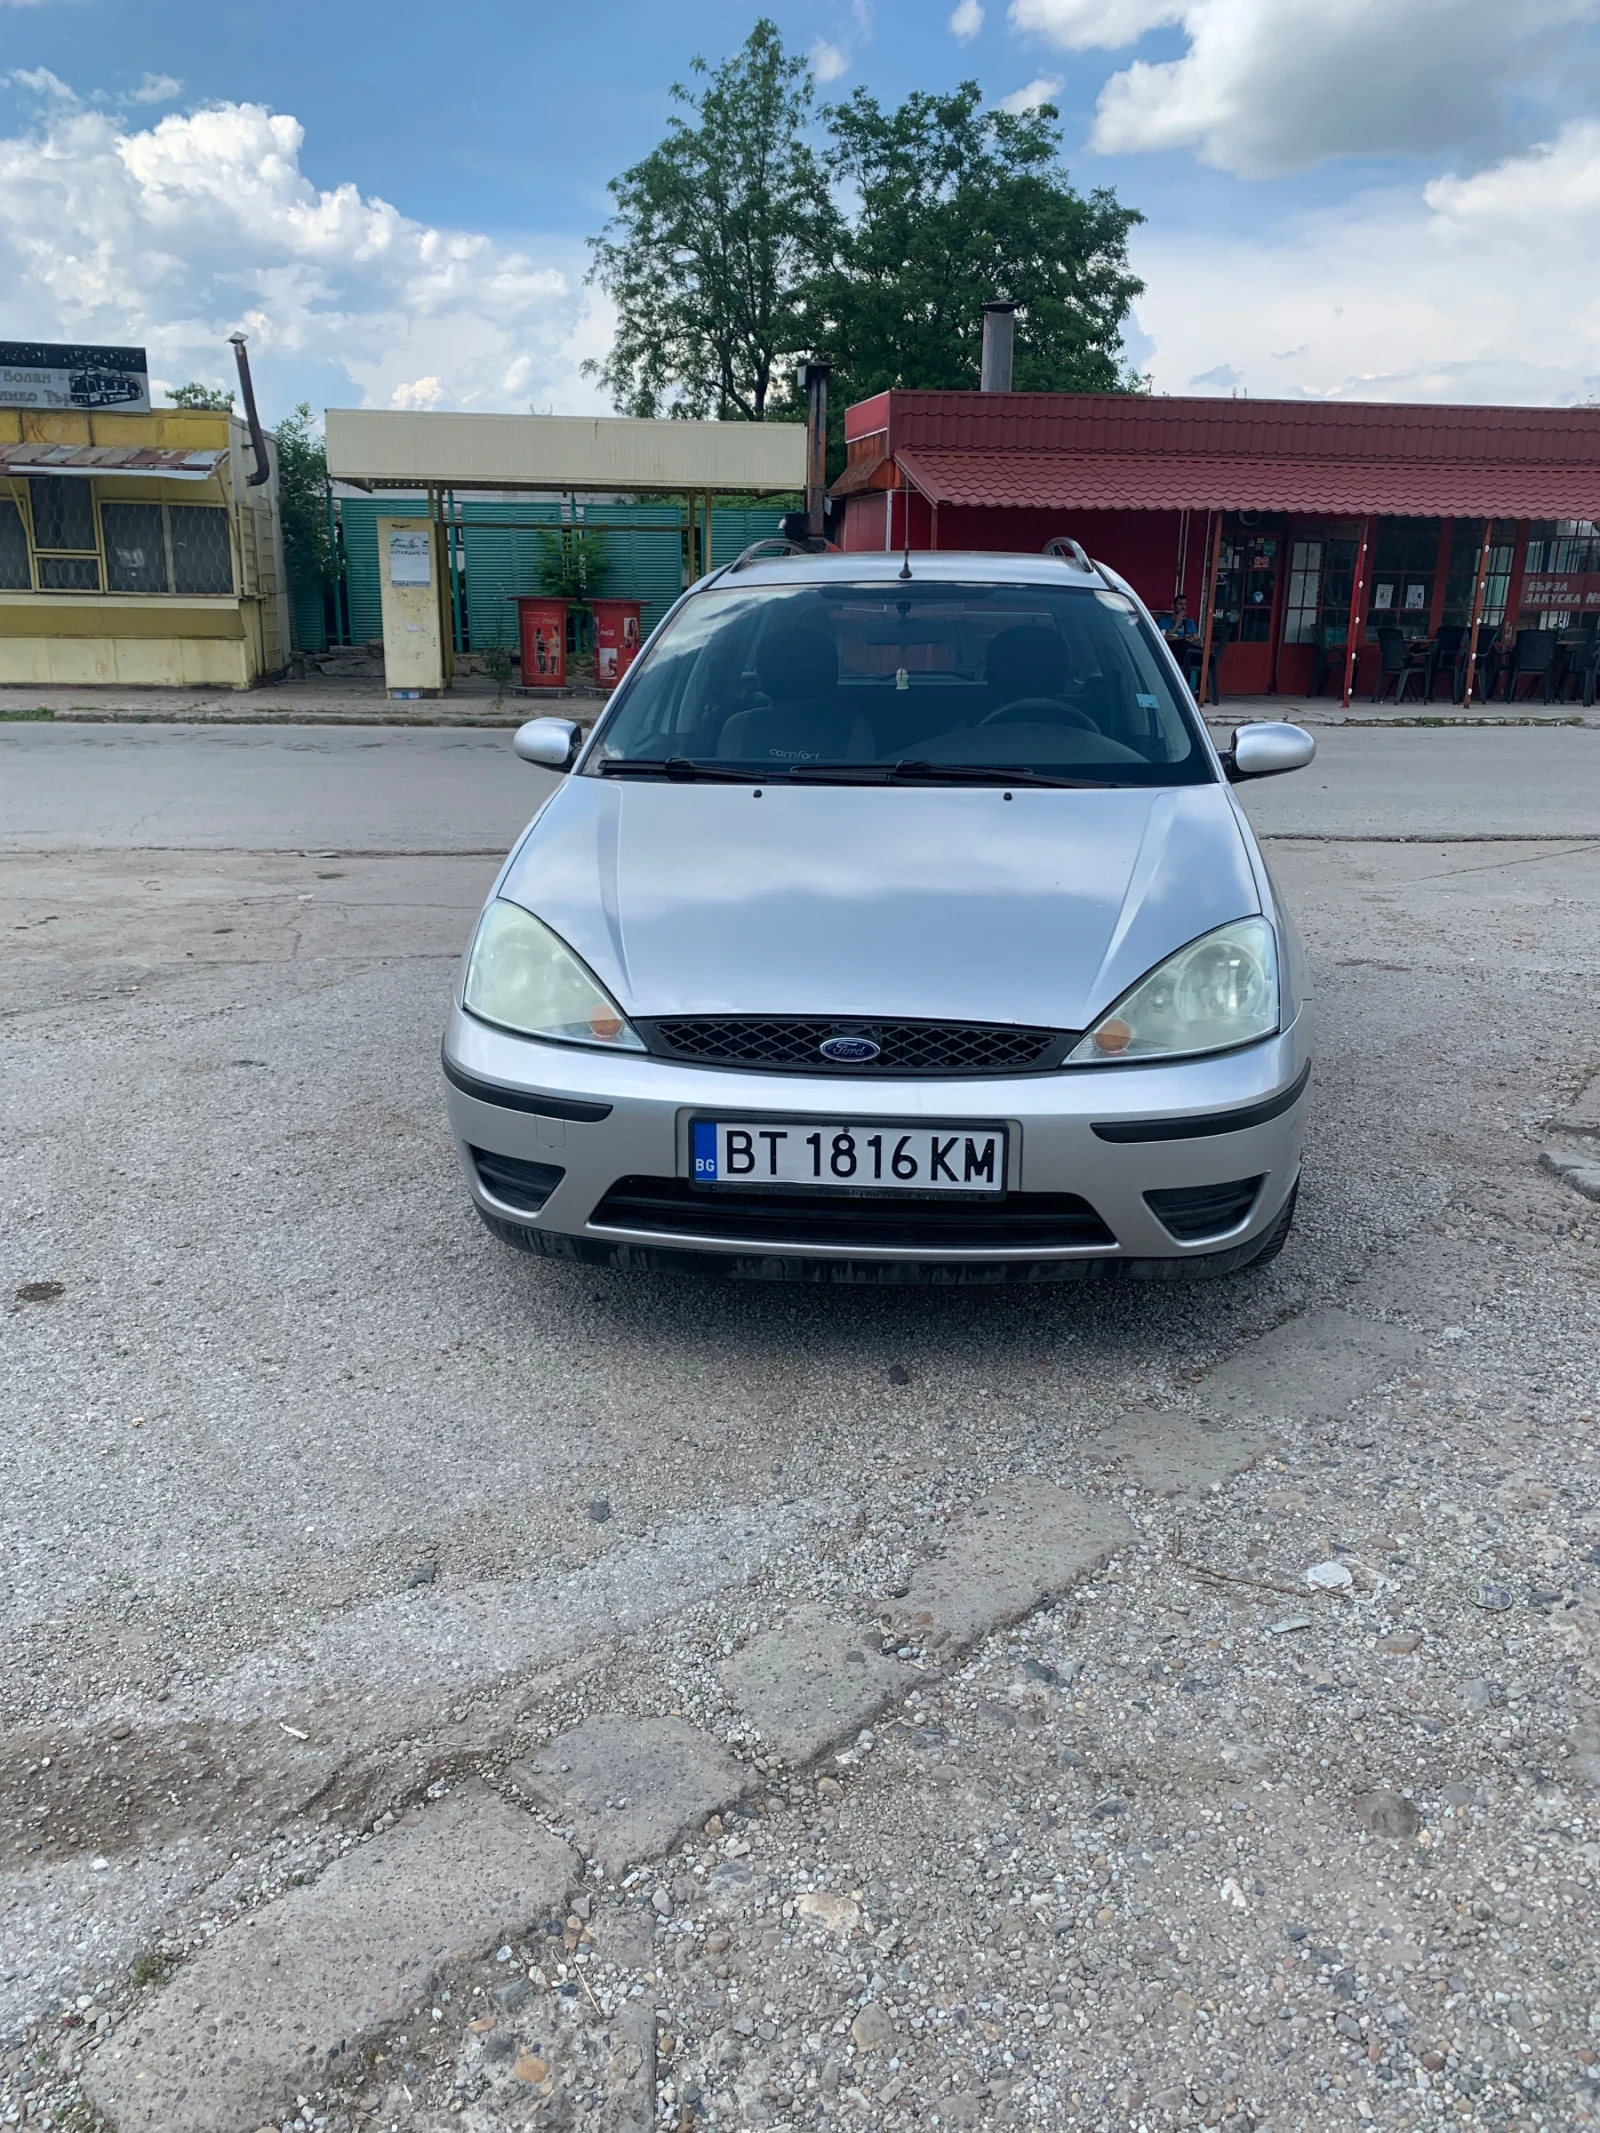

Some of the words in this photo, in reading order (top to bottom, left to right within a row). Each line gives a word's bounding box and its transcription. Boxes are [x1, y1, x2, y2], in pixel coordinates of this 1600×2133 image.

[1528, 581, 1568, 591] БЪРЗА
[1525, 593, 1581, 603] ЗАКУСКА
[769, 748, 819, 760] comfort
[832, 1041, 866, 1056] Ford
[695, 1158, 715, 1172] BG
[726, 1130, 788, 1175] BT
[806, 1132, 918, 1180] 1816
[931, 1137, 995, 1183] KM
